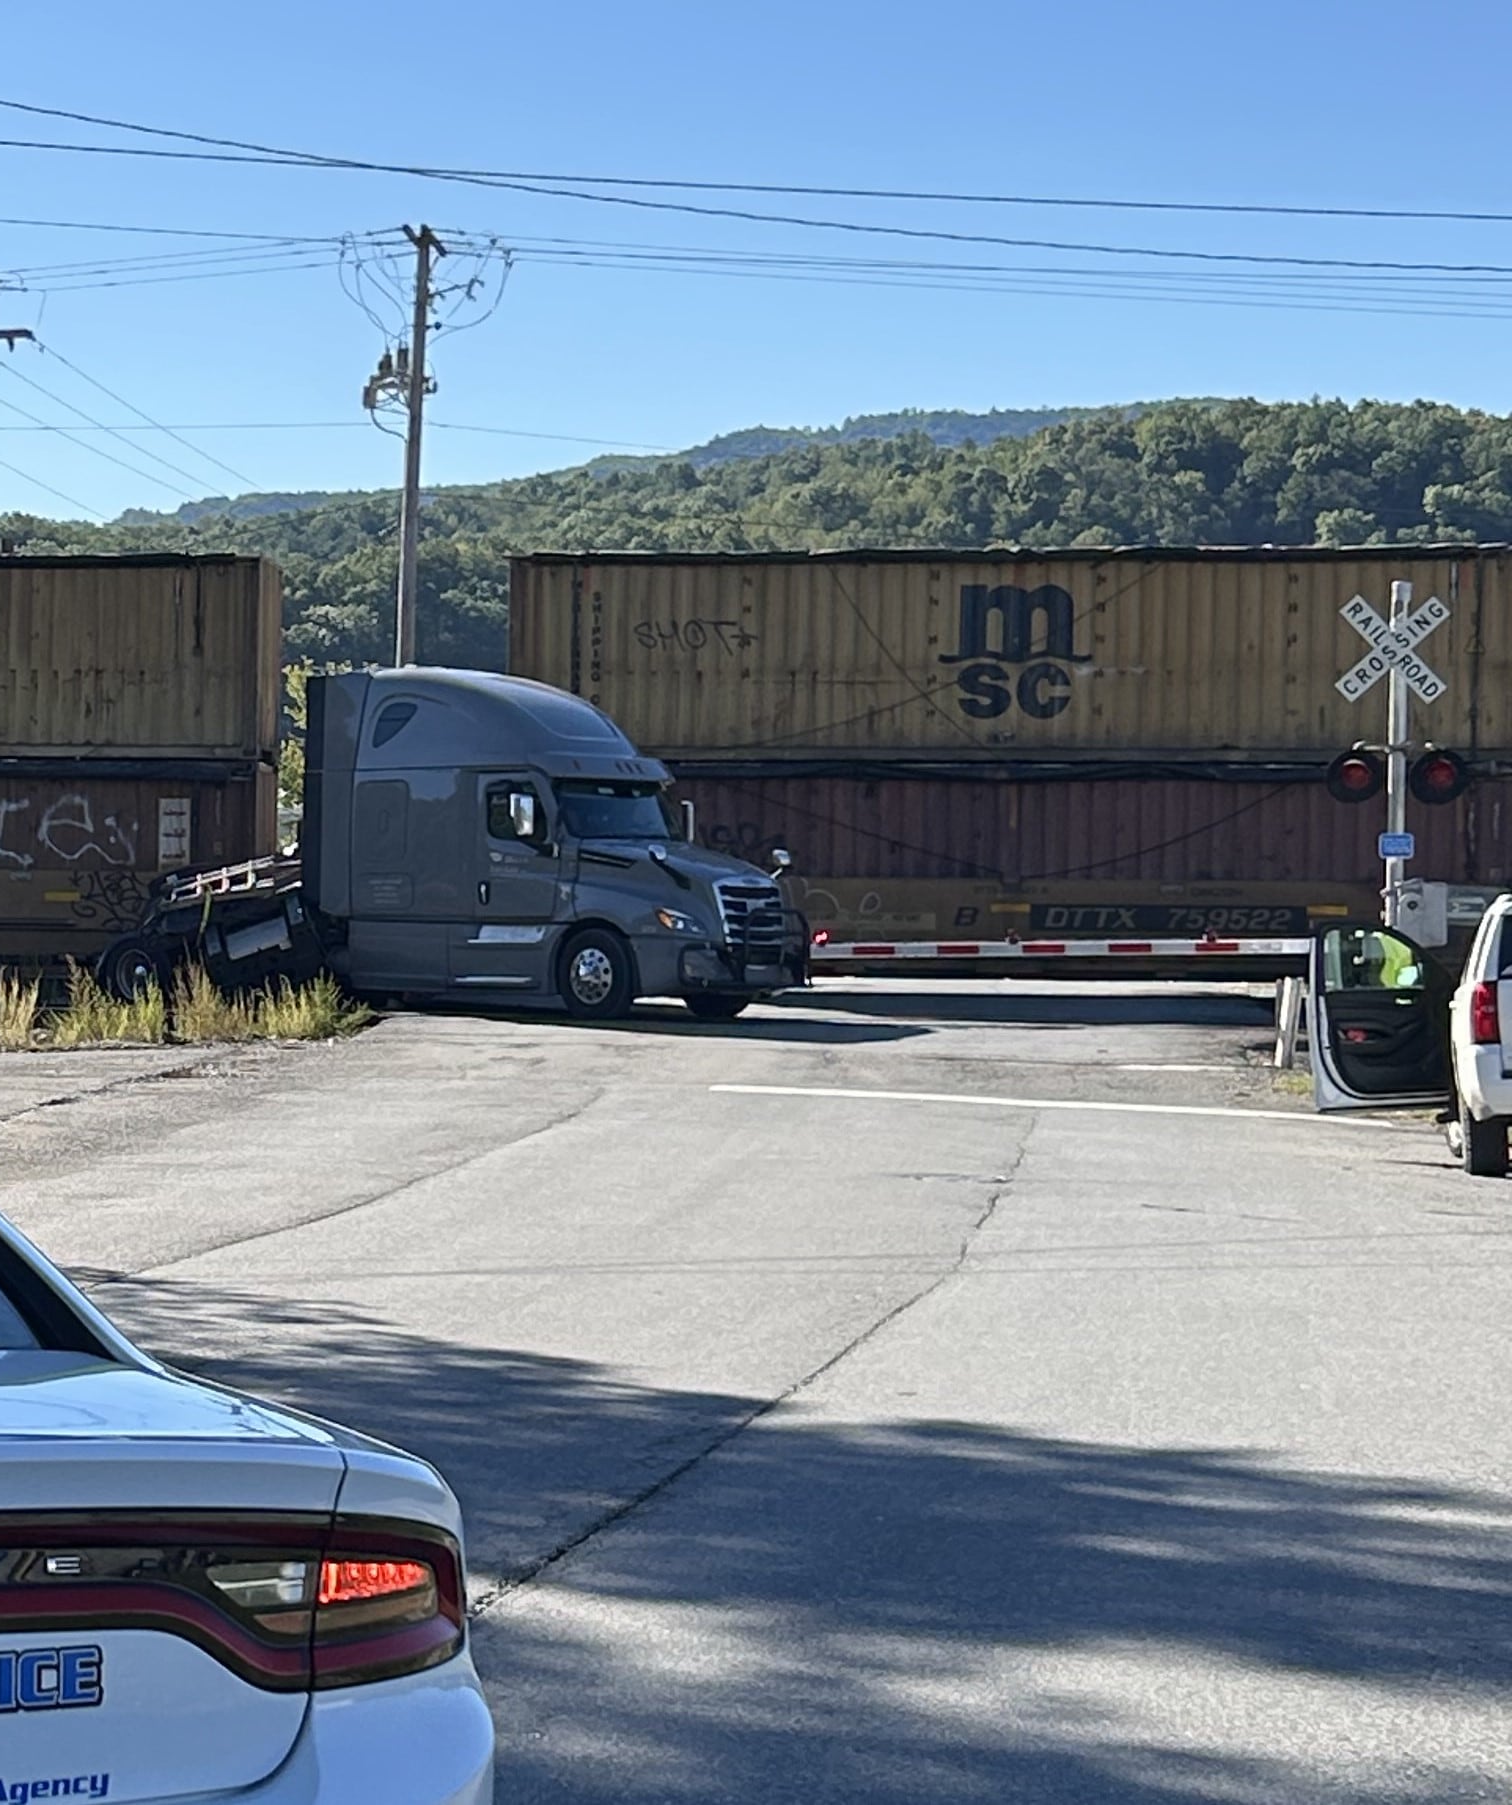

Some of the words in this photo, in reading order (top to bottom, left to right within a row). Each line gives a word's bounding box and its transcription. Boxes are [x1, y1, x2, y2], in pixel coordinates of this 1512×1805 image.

[1343, 603, 1444, 695] CROSSING
[1044, 907, 1138, 929] DTTX
[1167, 908, 1293, 931] 759522
